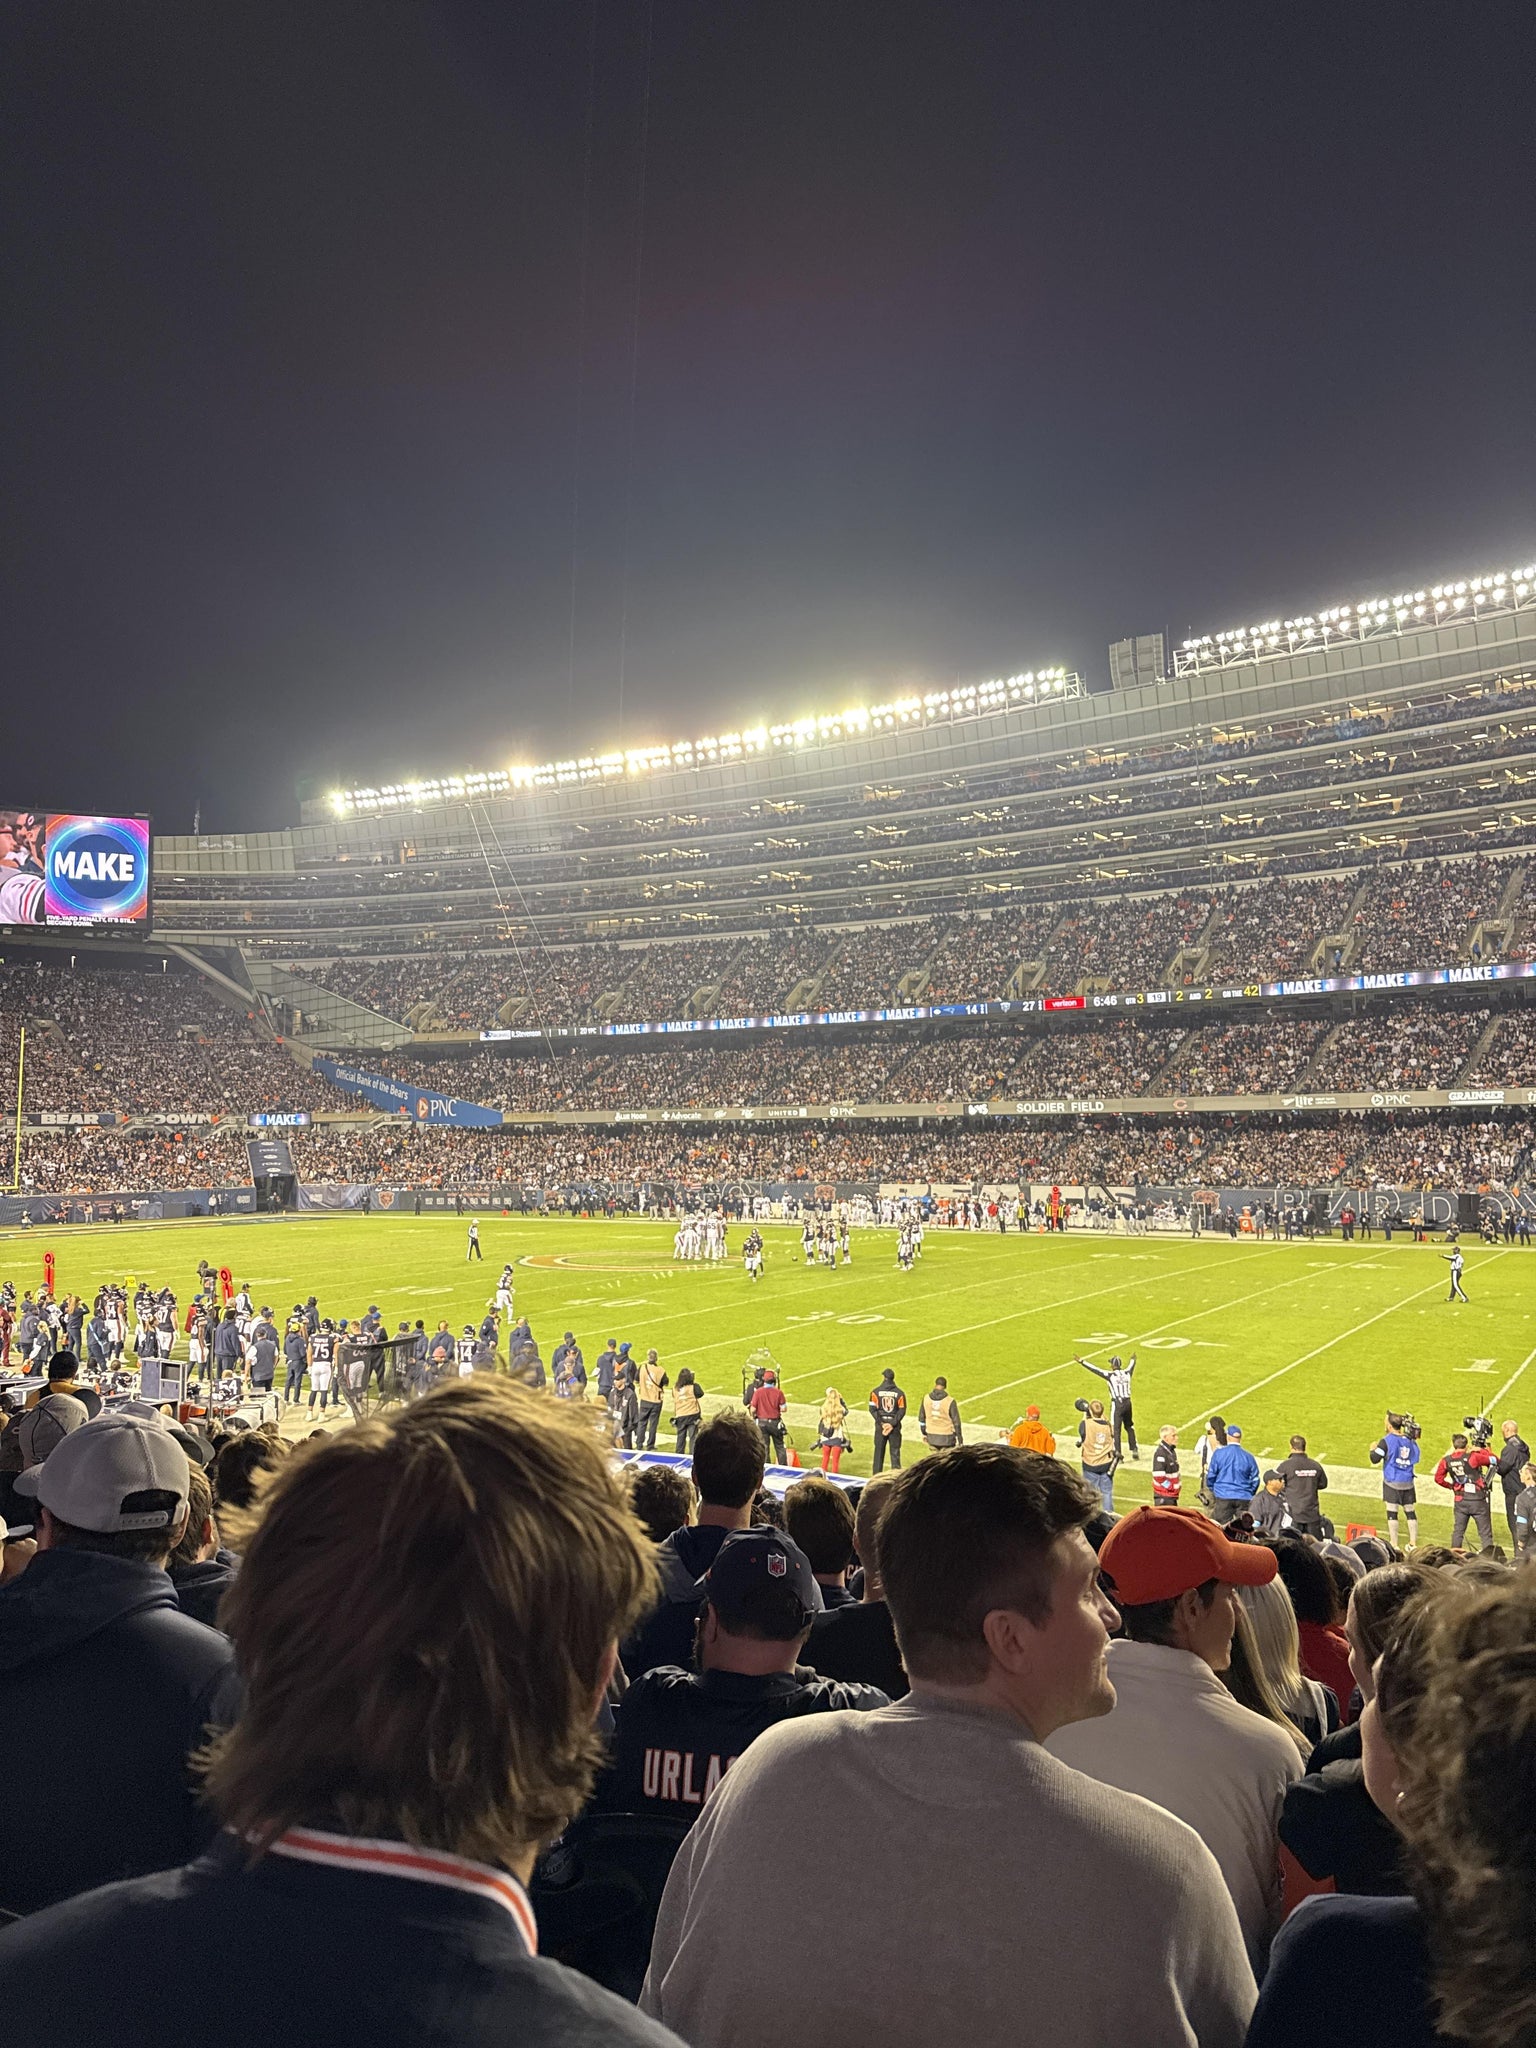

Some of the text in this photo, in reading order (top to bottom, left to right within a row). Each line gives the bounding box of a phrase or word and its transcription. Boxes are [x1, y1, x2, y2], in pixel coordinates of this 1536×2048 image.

[54, 851, 135, 881] MAKE
[1449, 966, 1493, 982] MAKE
[1282, 979, 1322, 994] MAKE
[1364, 973, 1405, 989] MAKE
[1136, 993, 1144, 1004] 3
[1152, 993, 1163, 1001] 19
[1175, 990, 1184, 1001] 2
[1204, 988, 1213, 999] 2
[1243, 985, 1258, 996] 42
[1022, 1001, 1035, 1011] 27
[1052, 1000, 1077, 1008] verizon
[1093, 995, 1117, 1006] 6:46
[886, 1008, 916, 1019] MAKE
[965, 1004, 978, 1015] 14
[773, 1015, 801, 1026] MAKE
[829, 1012, 857, 1023] MAKE
[616, 1024, 641, 1034] MAKE
[667, 1021, 693, 1031] MAKE
[720, 1018, 746, 1029] MAKE
[336, 1068, 408, 1100] Official Bank of the Bears
[1386, 1094, 1411, 1104] PNC
[1448, 1091, 1504, 1100] GRAINGER
[1016, 1101, 1104, 1113] SOLDIER FIELD
[1295, 1096, 1313, 1108] Lite
[430, 1100, 457, 1116] PNC
[839, 1107, 857, 1116] PNC
[41, 1114, 100, 1125] BEAR
[266, 1113, 297, 1126] MAKE
[670, 1111, 702, 1120] Advocate
[313, 1343, 329, 1358] 75
[461, 1346, 472, 1361] 14
[218, 1380, 238, 1395] 54
[643, 1748, 737, 1803] URLA
